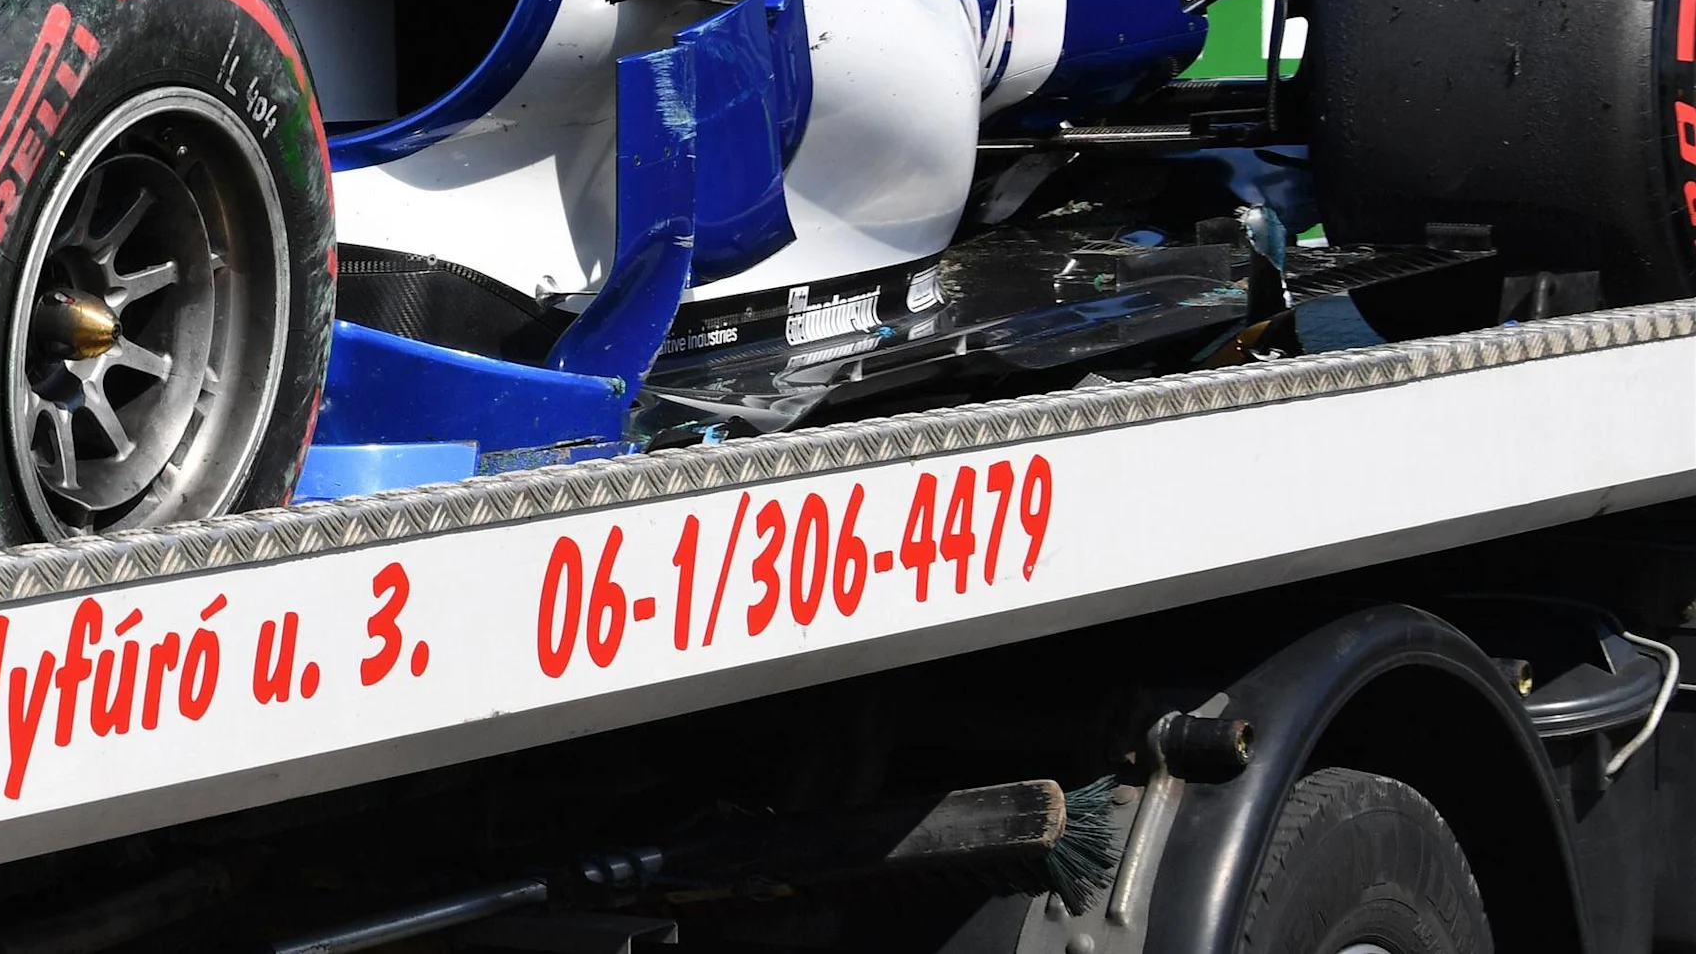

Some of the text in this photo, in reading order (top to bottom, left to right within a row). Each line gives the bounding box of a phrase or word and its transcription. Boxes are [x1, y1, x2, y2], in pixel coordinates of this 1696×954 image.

[252, 610, 320, 706] u.
[360, 561, 430, 687] 3.
[537, 453, 1052, 680] 06-1/306-4479
